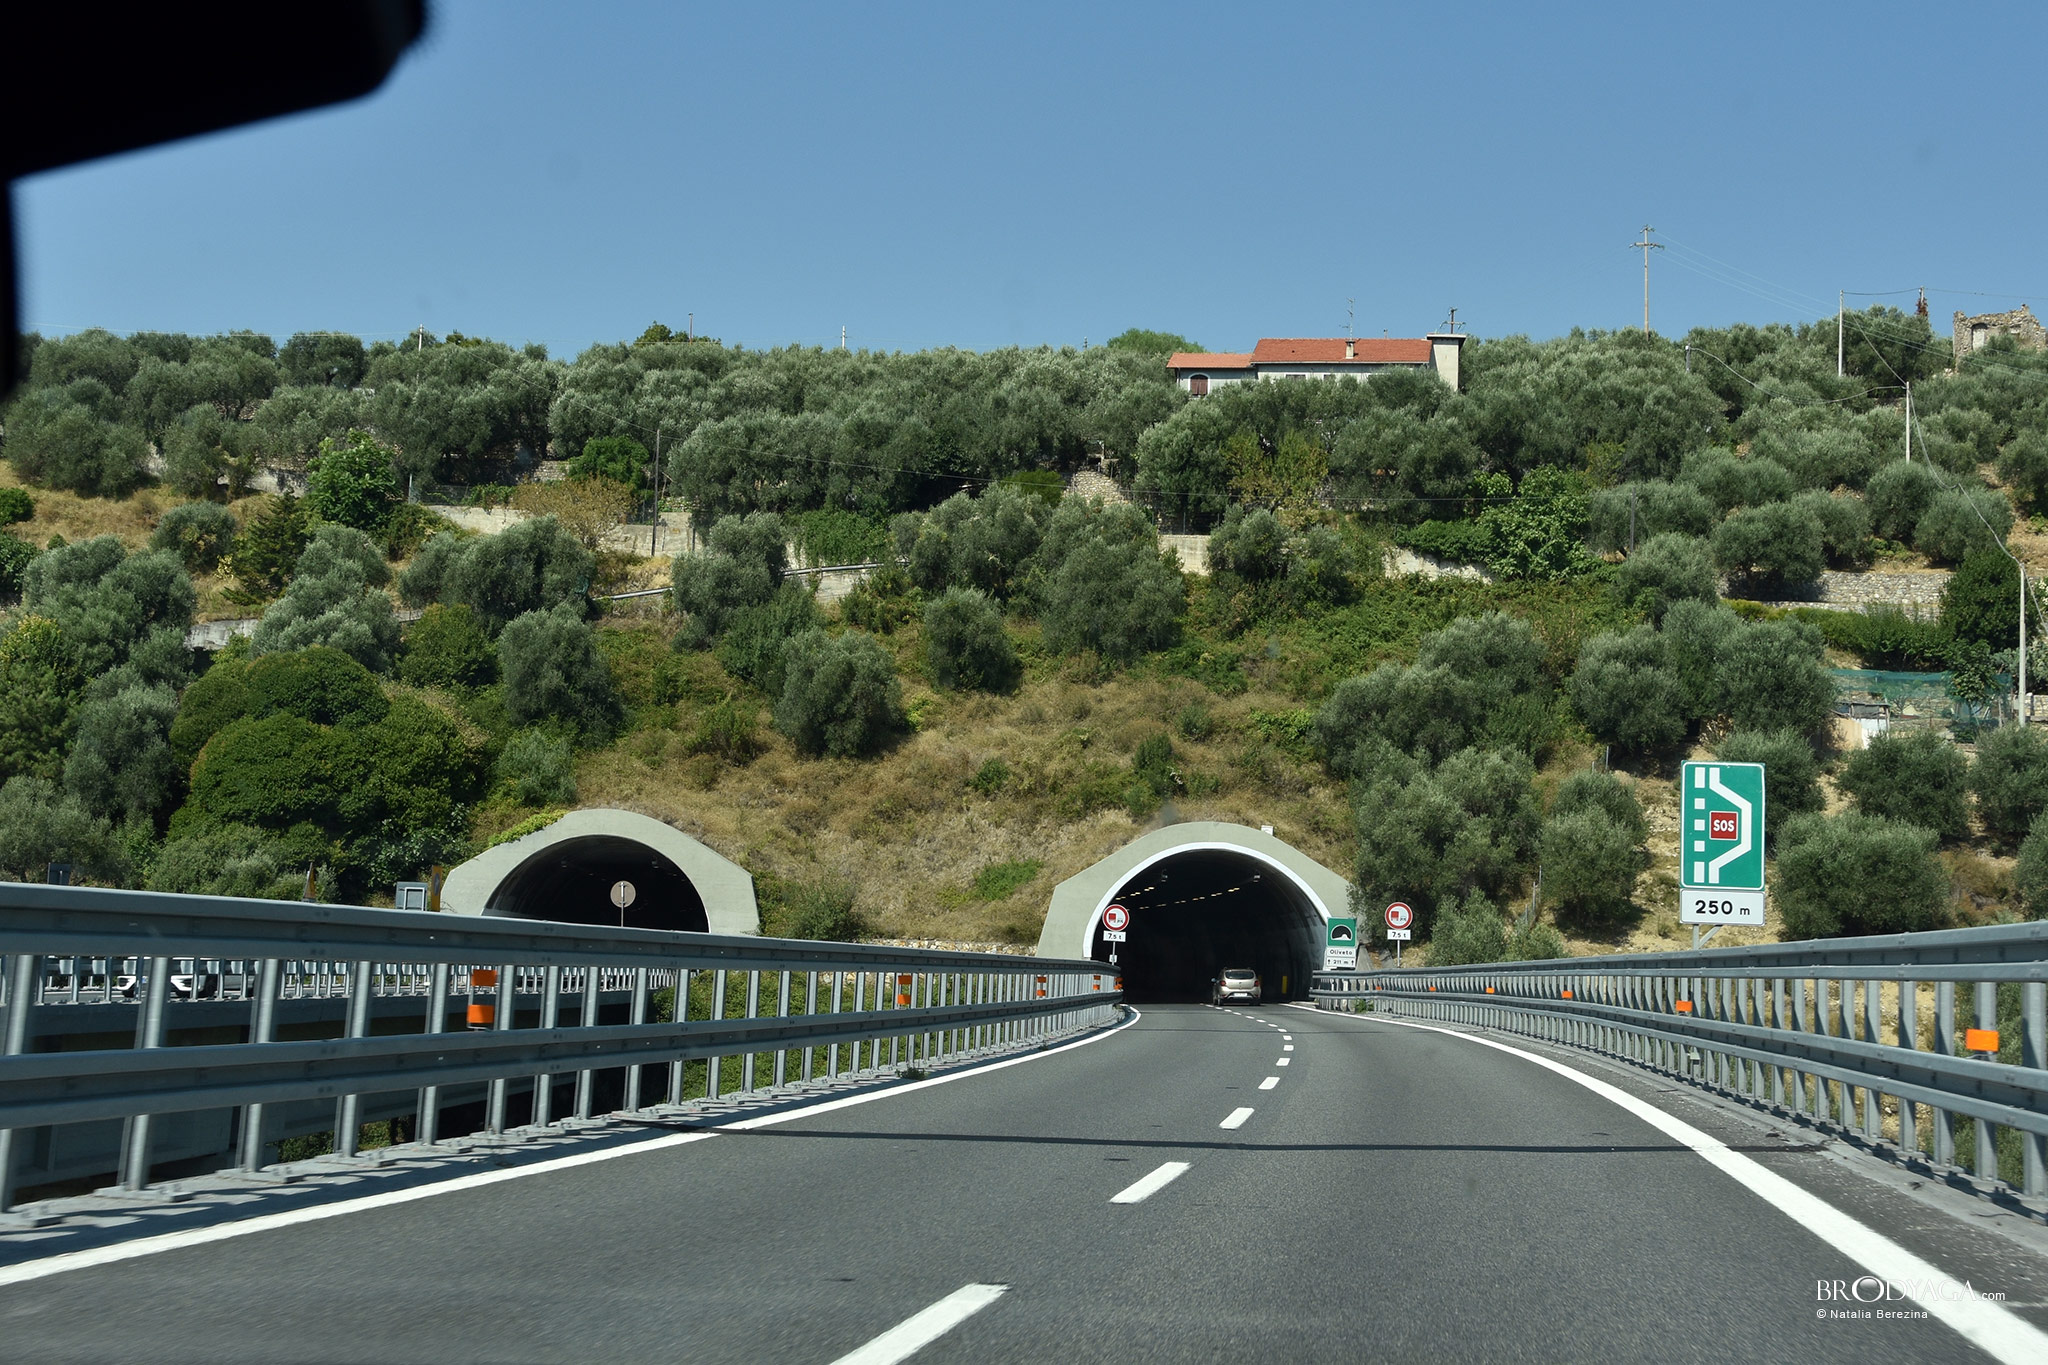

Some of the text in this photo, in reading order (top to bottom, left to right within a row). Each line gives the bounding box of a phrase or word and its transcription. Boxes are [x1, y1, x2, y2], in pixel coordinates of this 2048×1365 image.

[1713, 819, 1735, 832] SOS
[1695, 899, 1750, 915] 250 m
